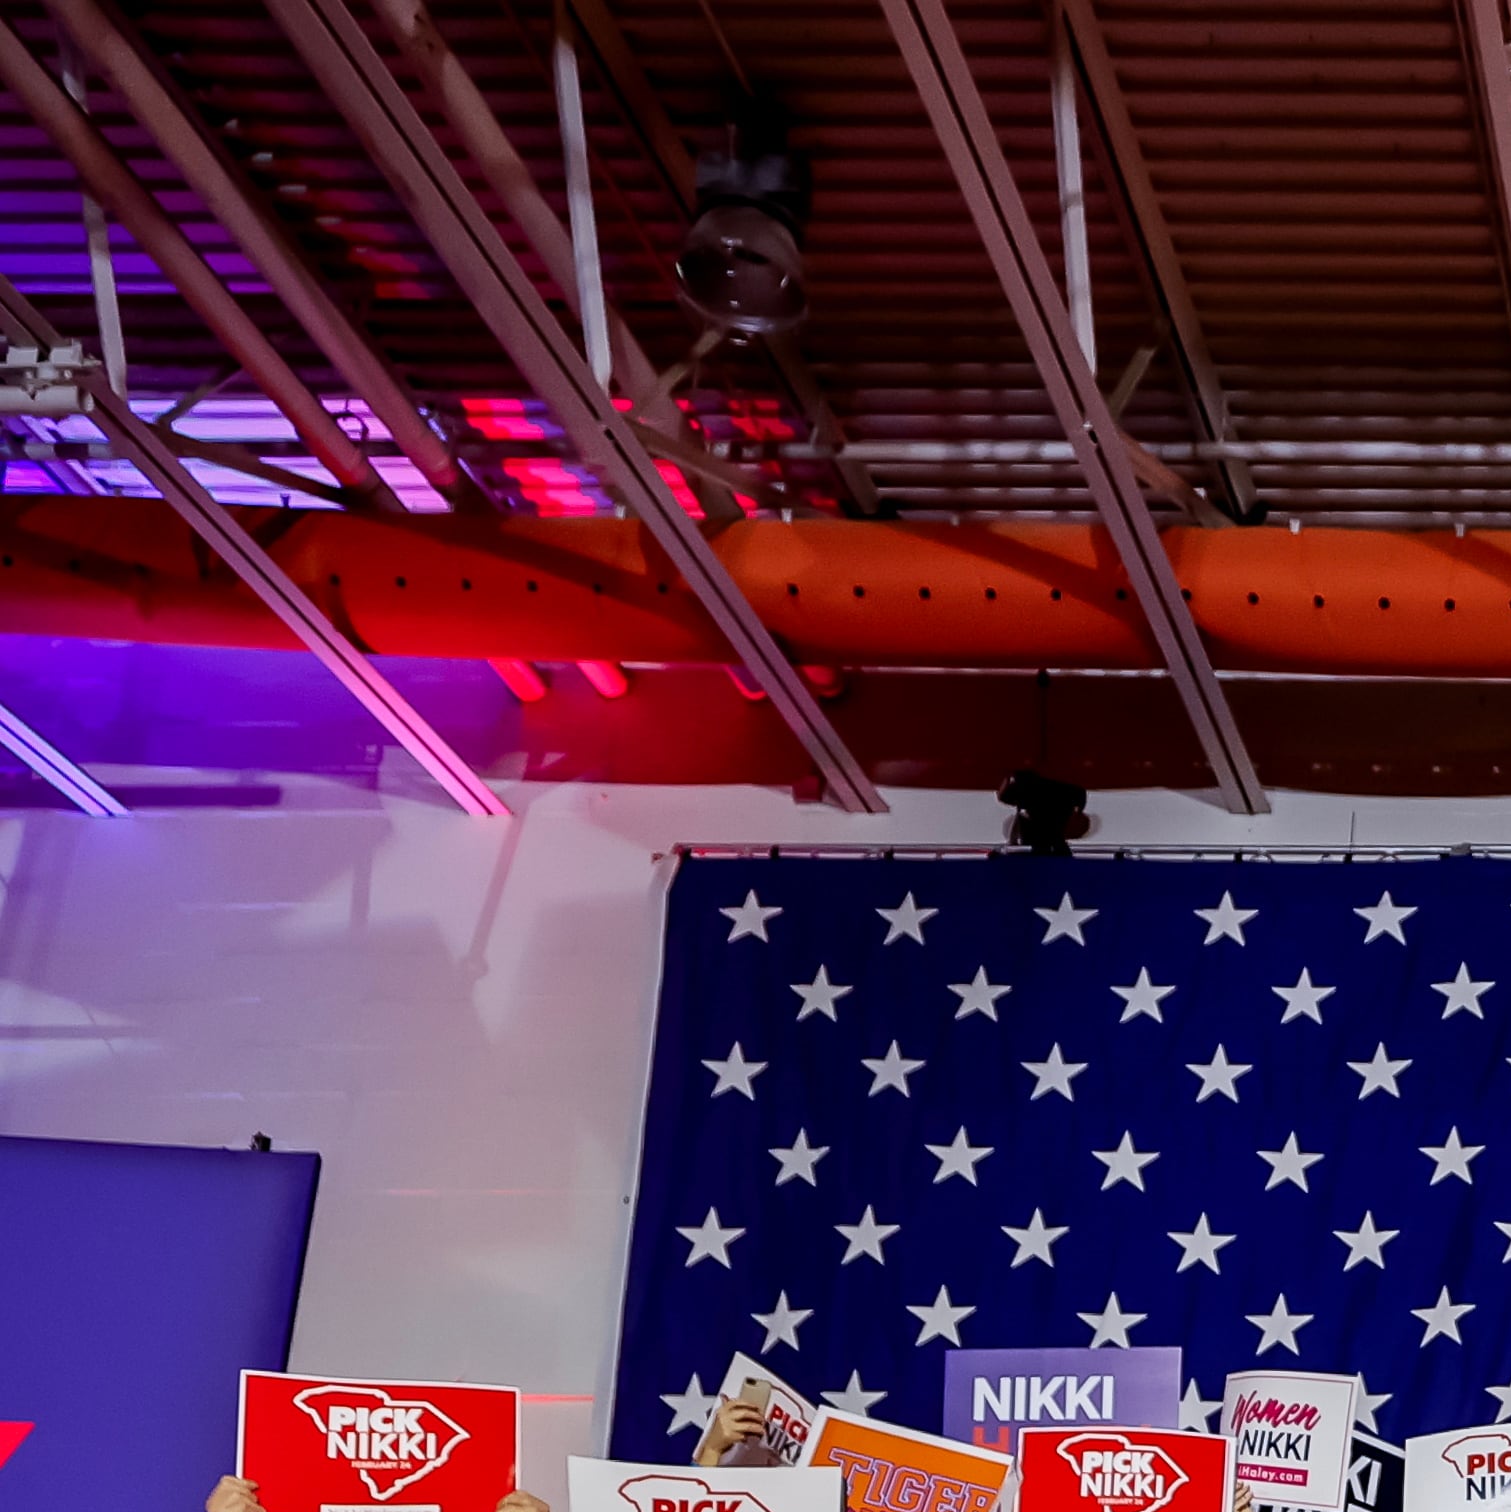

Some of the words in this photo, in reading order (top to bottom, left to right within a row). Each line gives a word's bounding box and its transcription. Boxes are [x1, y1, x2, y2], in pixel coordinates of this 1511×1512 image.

[973, 1375, 1113, 1422] NIKKI
[1231, 1390, 1322, 1436] Women
[328, 1405, 424, 1433] PICK
[327, 1431, 437, 1460] NIKKI
[764, 1421, 803, 1464] NIK
[1240, 1430, 1312, 1461] NIKKI
[1082, 1450, 1155, 1475] PICK
[1238, 1466, 1304, 1483] iHaley.com
[1080, 1473, 1164, 1499] NIKKI
